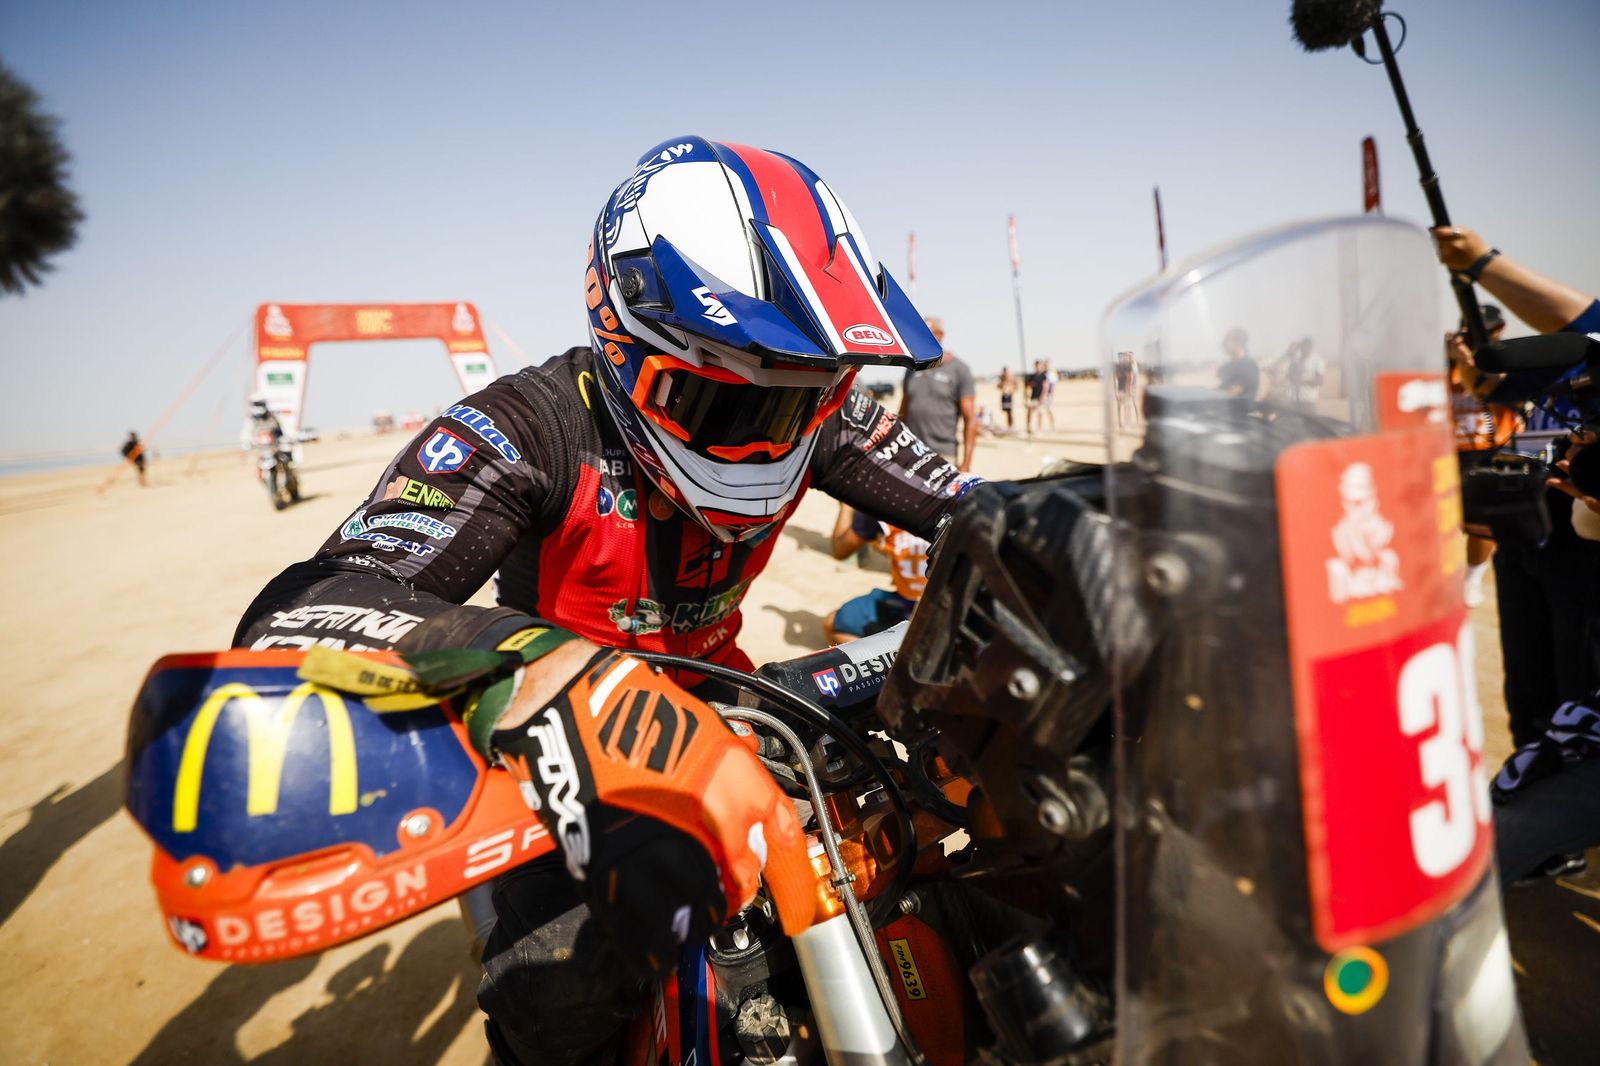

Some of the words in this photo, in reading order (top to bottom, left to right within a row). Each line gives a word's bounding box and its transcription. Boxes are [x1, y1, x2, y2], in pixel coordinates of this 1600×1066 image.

[850, 329, 888, 343] BELL
[442, 404, 522, 465] Mitas
[215, 864, 430, 946] DESIGN
[898, 960, 922, 998] 9639
